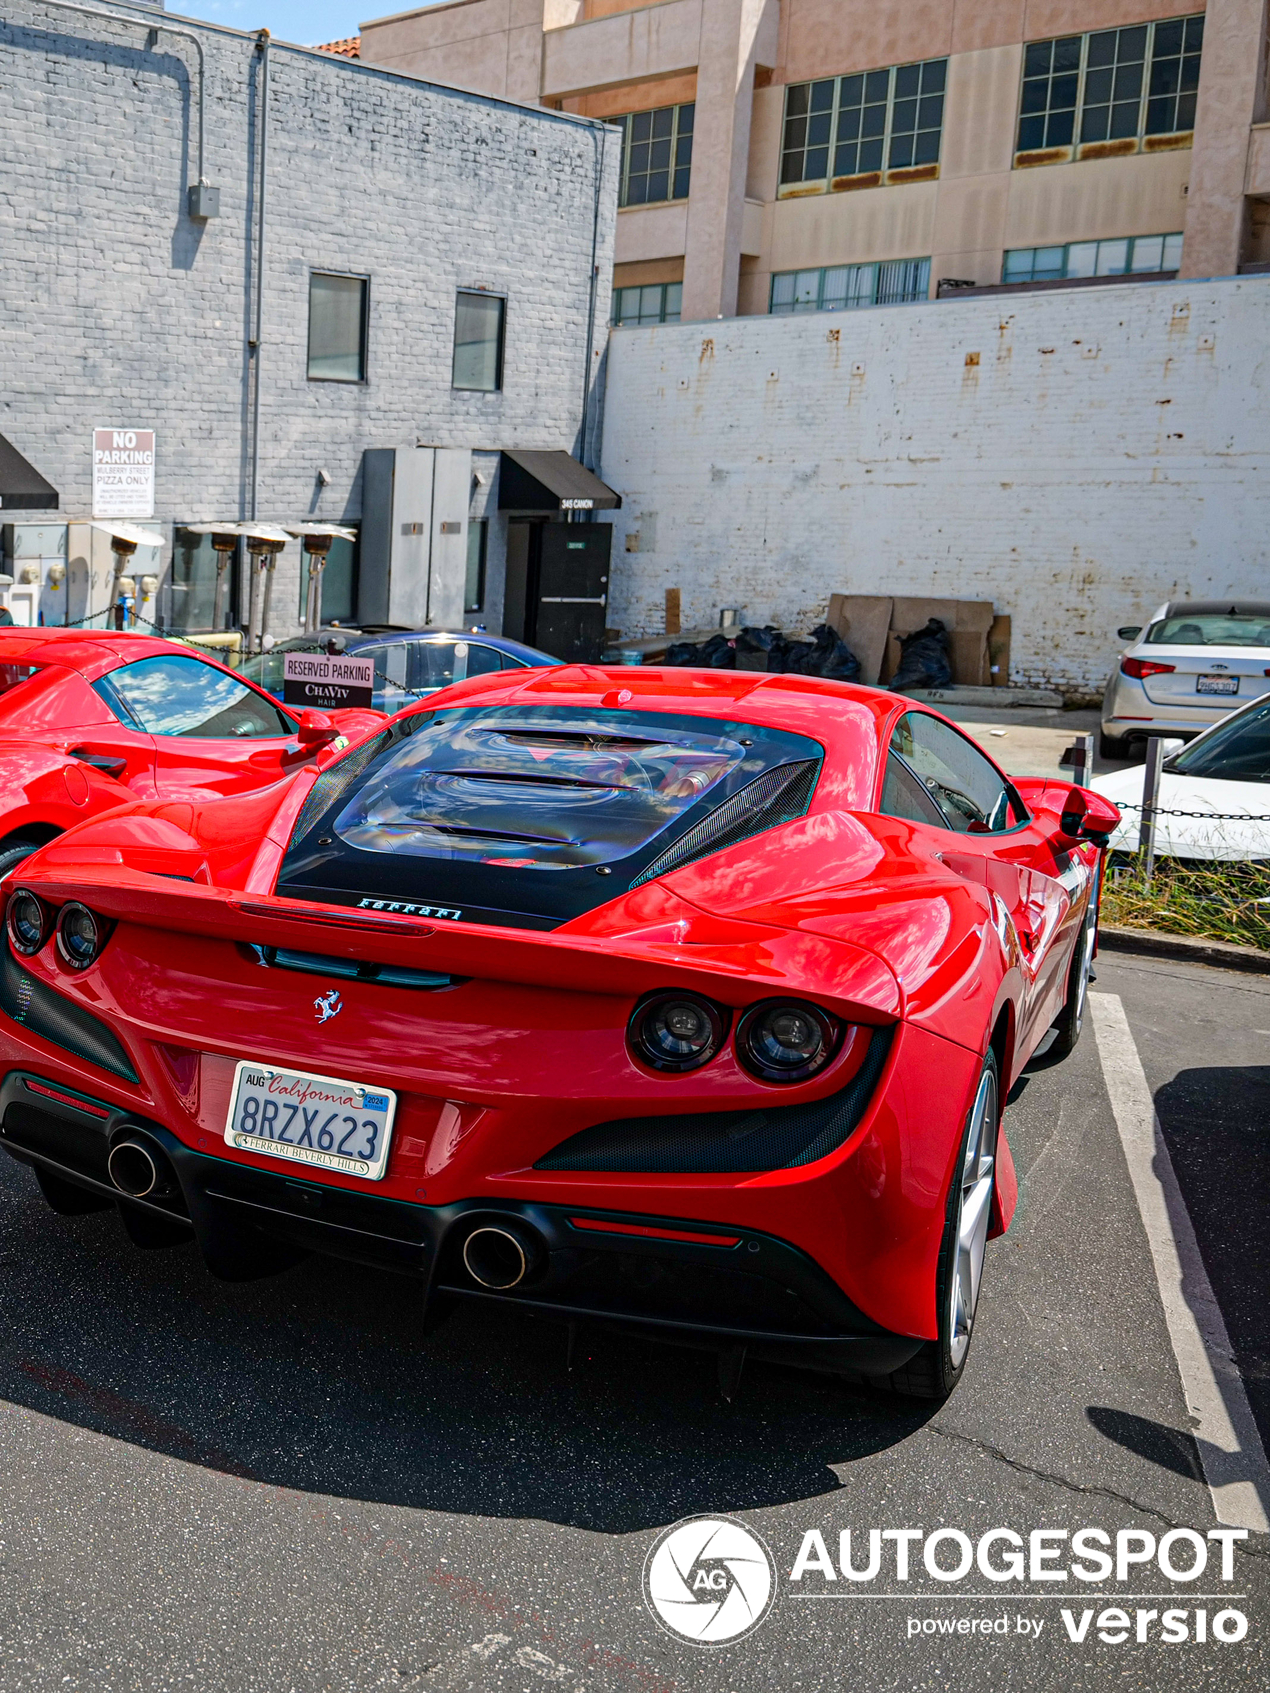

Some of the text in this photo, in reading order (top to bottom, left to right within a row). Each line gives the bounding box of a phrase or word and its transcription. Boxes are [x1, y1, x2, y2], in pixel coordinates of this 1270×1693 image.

[112, 432, 137, 448] NO
[94, 450, 152, 464] PARKING
[96, 466, 150, 475] MULBERRY STREET
[96, 476, 150, 485] PIZZA ONLY
[573, 498, 594, 509] CANON
[288, 660, 371, 682] RESERVED PARKING
[318, 698, 336, 707] HAIR
[356, 898, 462, 920] Ferrari
[246, 1074, 364, 1110] AUG California
[368, 1096, 384, 1106] 2024
[240, 1096, 378, 1160] 8RZX623
[250, 1138, 366, 1173] FERRARI BEVERLY HILLS
